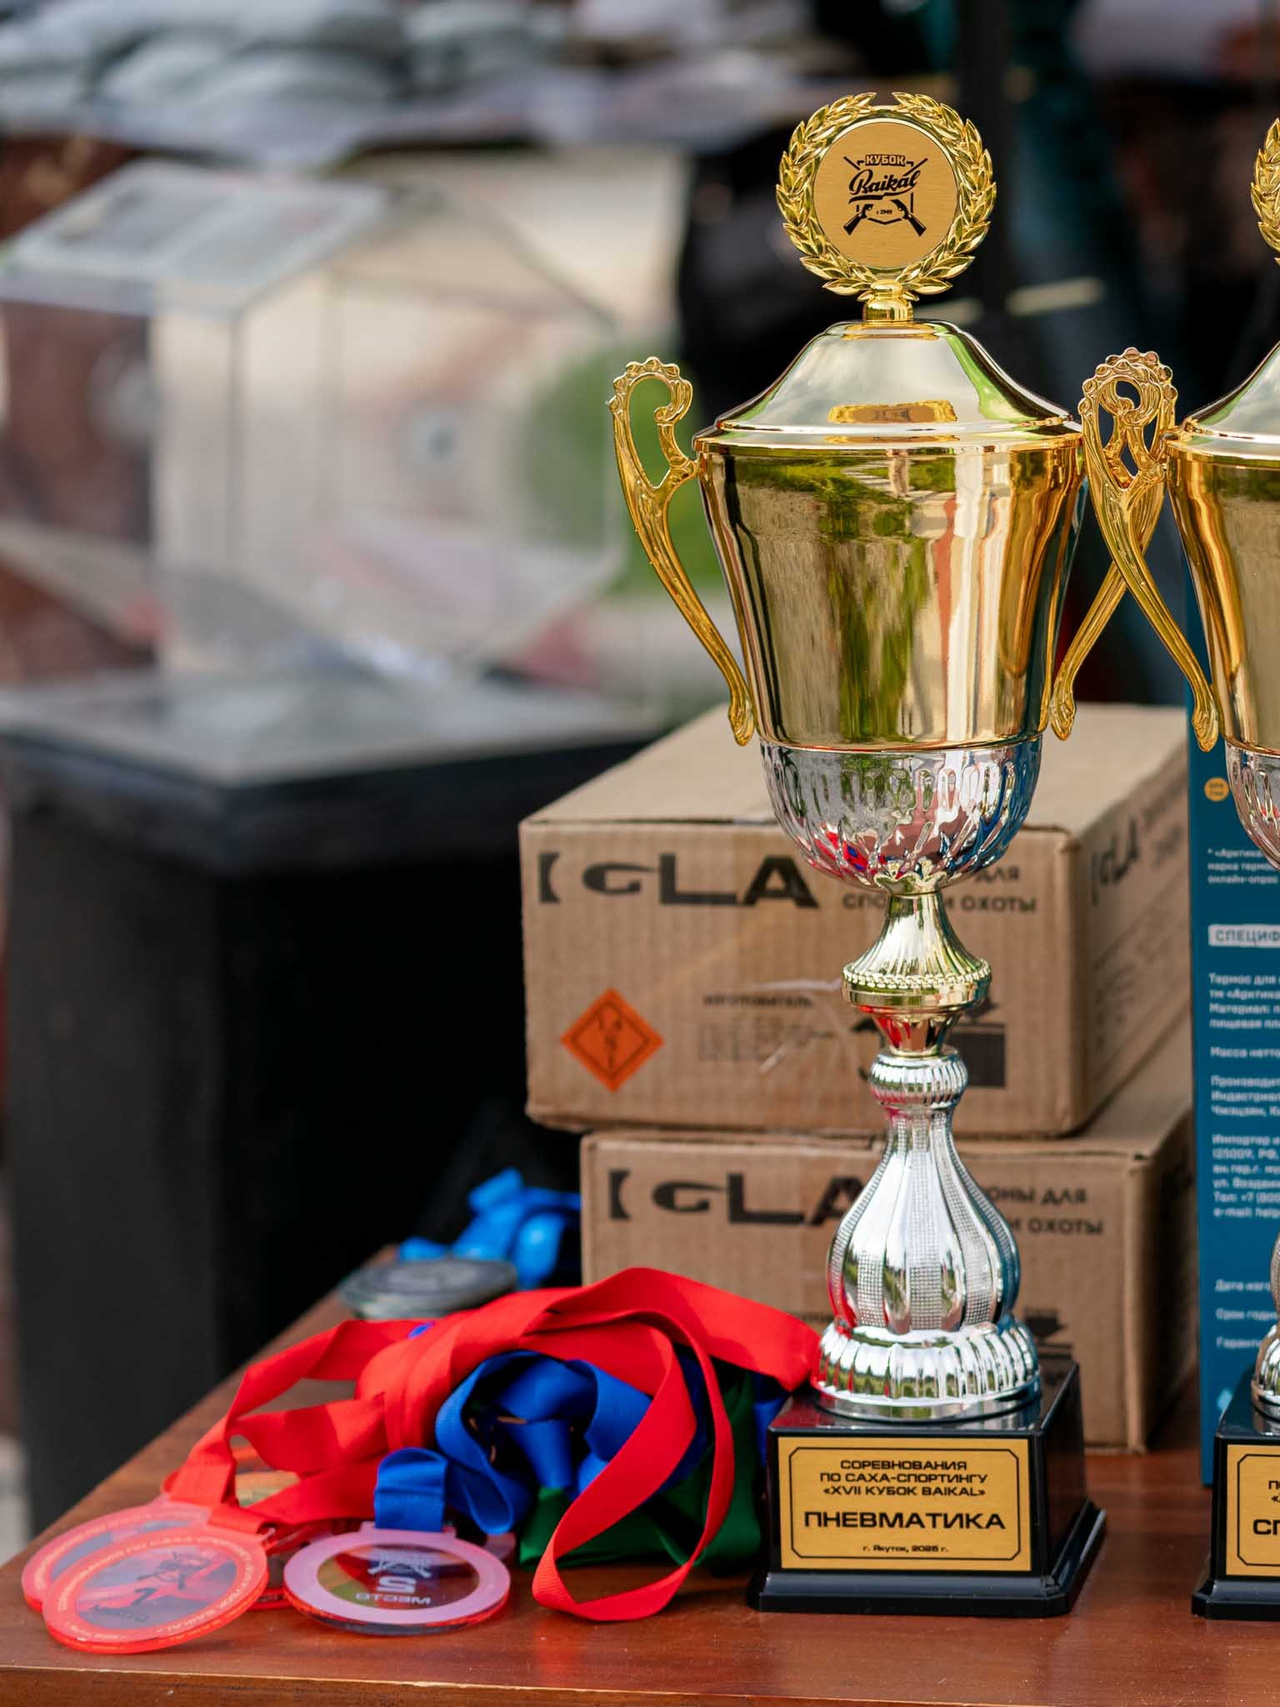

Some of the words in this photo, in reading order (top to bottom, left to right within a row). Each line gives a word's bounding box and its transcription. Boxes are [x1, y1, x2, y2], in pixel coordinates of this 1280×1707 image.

[865, 154, 906, 166] КУБОК
[848, 169, 921, 196] Baikal
[961, 896, 1037, 912] ОХОТЫ
[1040, 1187, 1087, 1204] ДЛЯ
[1028, 1219, 1104, 1235] ОХОТЫ
[840, 1460, 967, 1471] СОРЕВНОВАНИЯ
[820, 1473, 841, 1482] ПО
[845, 1473, 988, 1484] САХА-СПОРТИНГУ
[823, 1486, 861, 1496] «XVII
[865, 1486, 917, 1497] КУБОК
[921, 1487, 986, 1497] BAIKAL»
[804, 1511, 1006, 1530] ПНЕВМАТИКА
[873, 1544, 909, 1553] Якутск,
